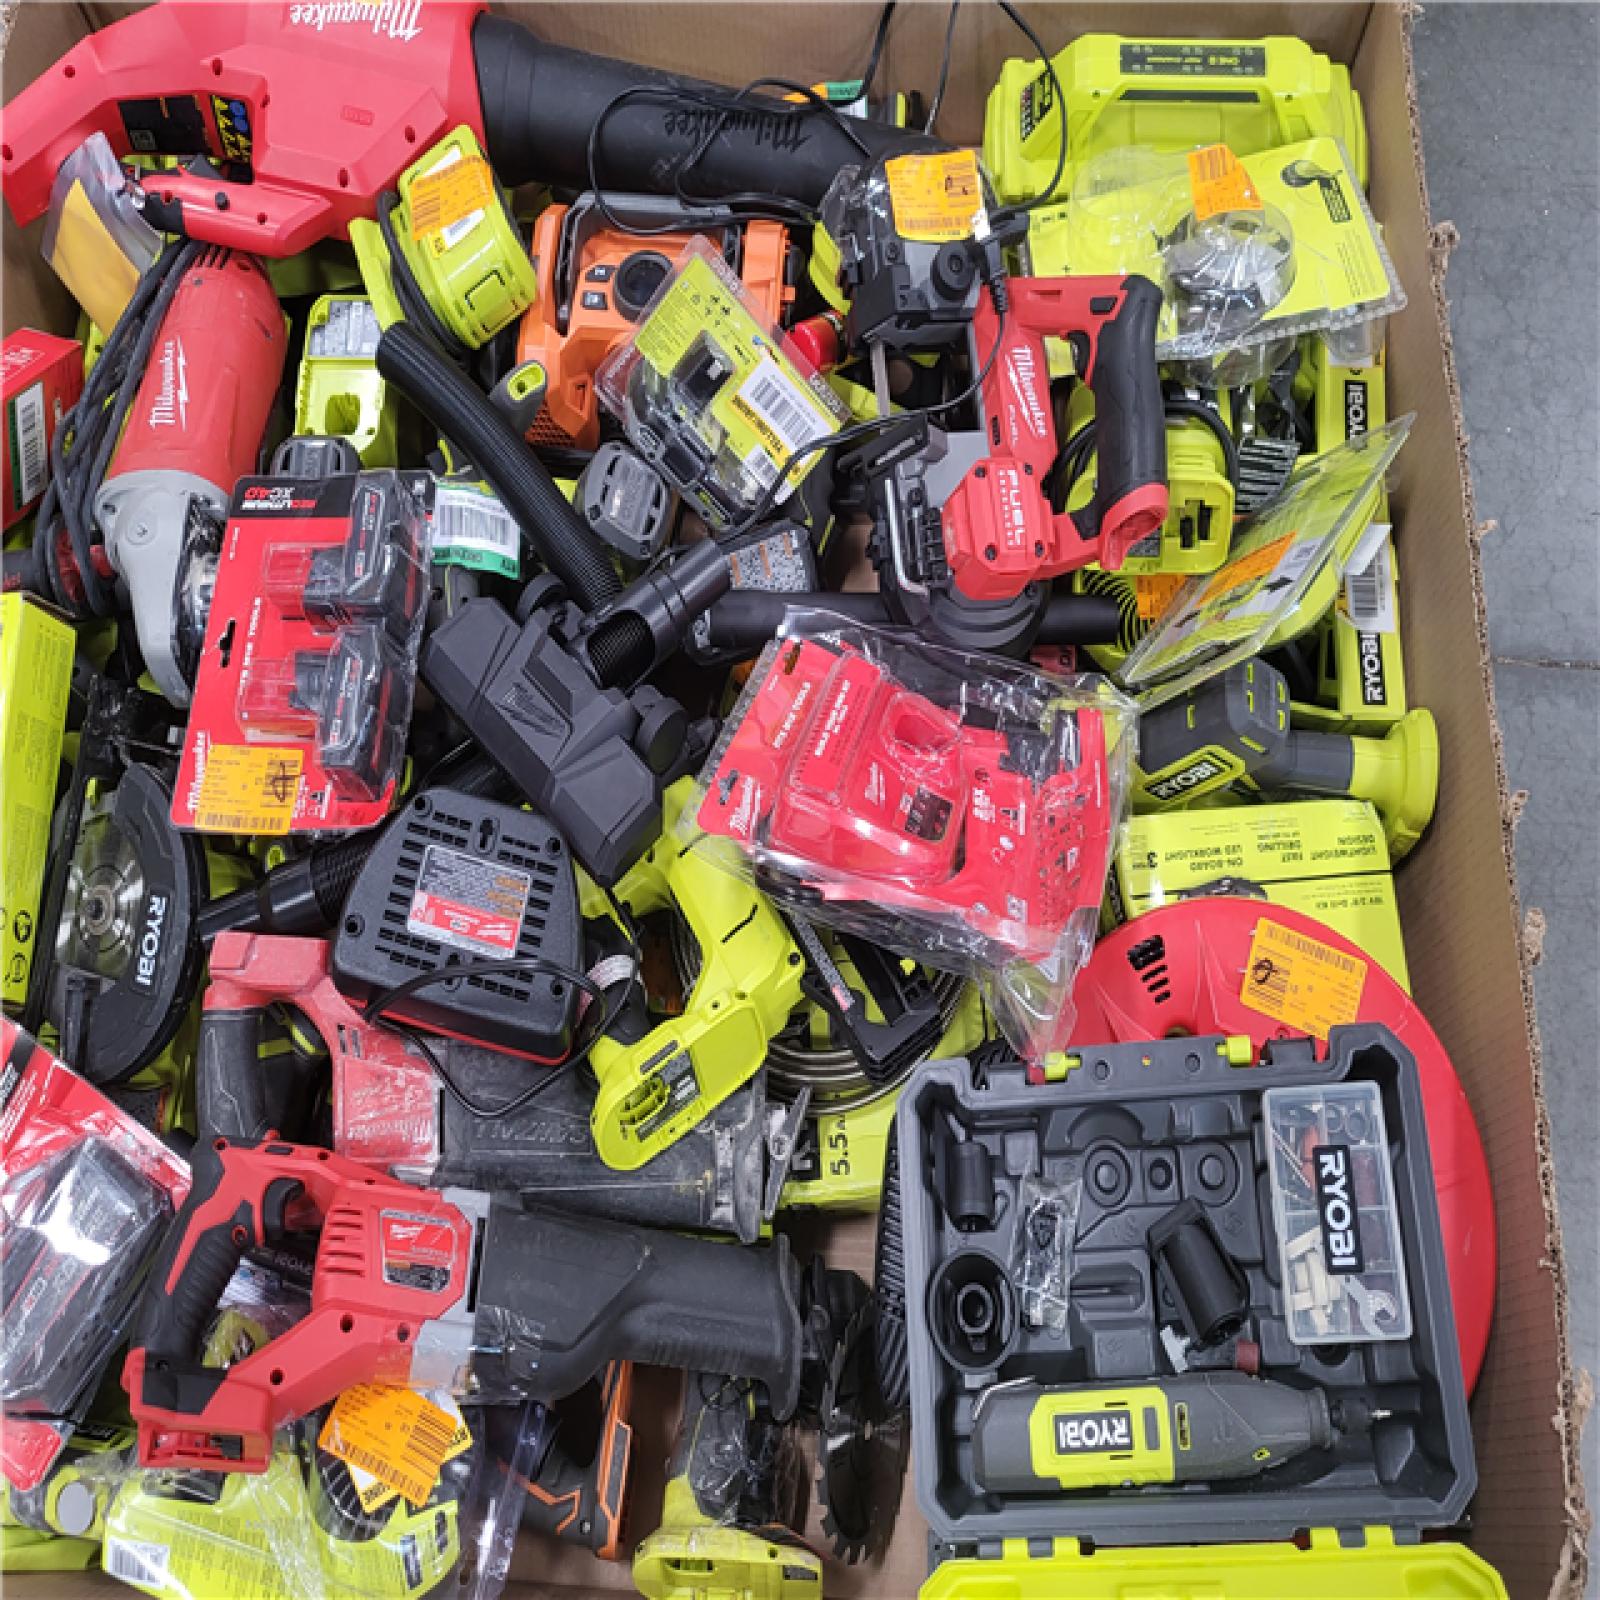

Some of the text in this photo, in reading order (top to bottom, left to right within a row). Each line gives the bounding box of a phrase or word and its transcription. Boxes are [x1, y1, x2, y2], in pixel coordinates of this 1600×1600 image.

[289, 0, 423, 41] Milwaukee
[664, 109, 812, 154] Milwaukee
[149, 341, 176, 430] Milwaukee
[1010, 345, 1047, 438] Milwaukee
[1007, 469, 1025, 546] FUEL
[1361, 633, 1384, 703] RYOBI
[1150, 761, 1220, 798] RYOBI
[1146, 851, 1158, 869] 3
[134, 895, 168, 985] RYOBI
[1320, 1149, 1357, 1266] RYOBI
[1059, 1416, 1131, 1448] RYOBI
